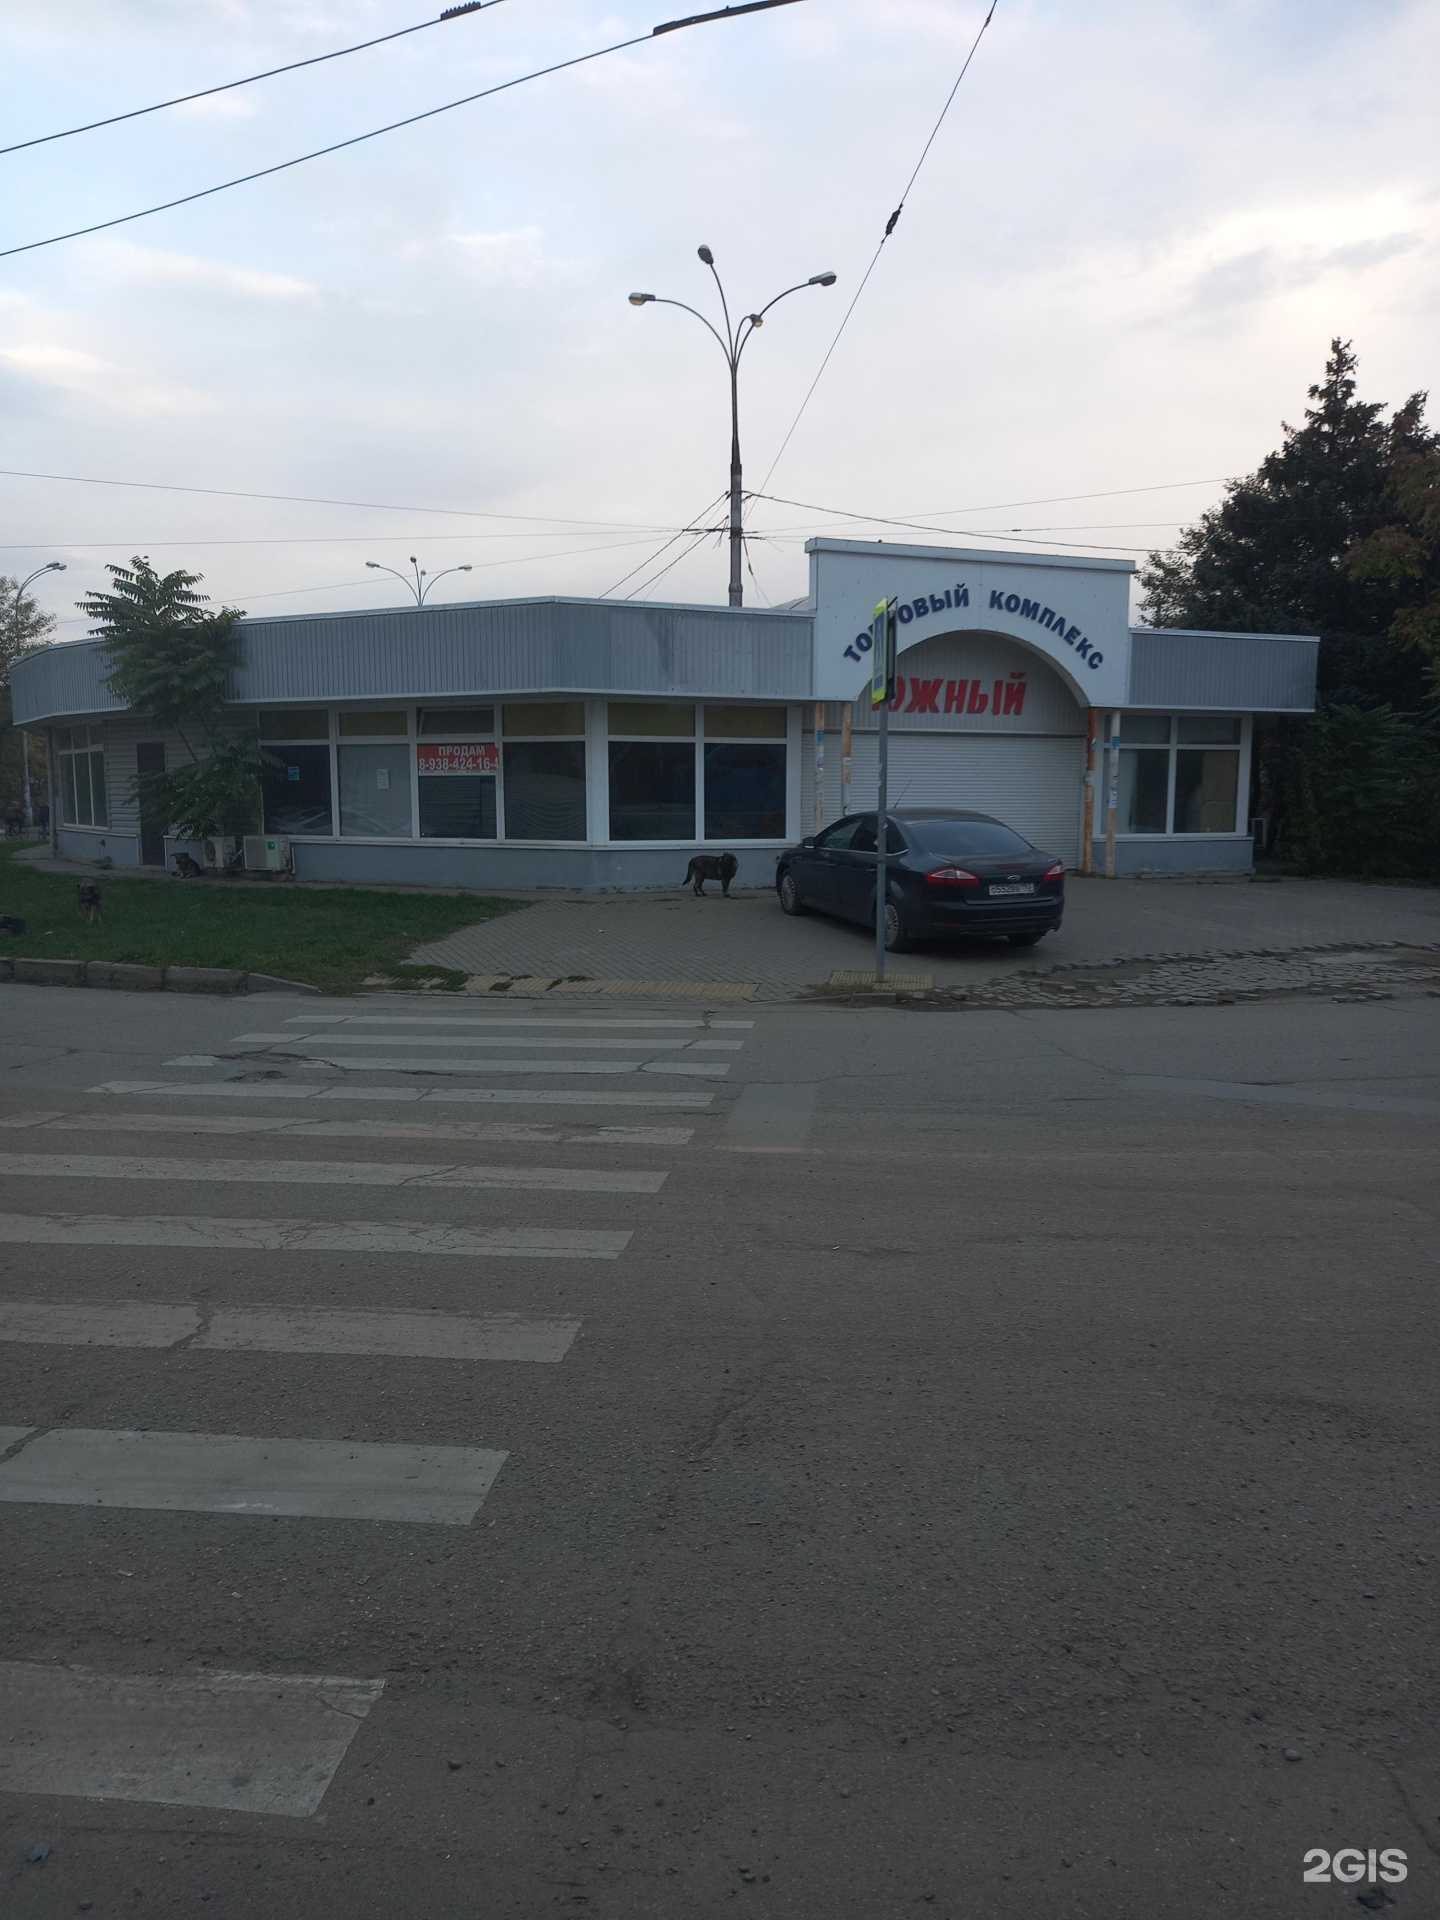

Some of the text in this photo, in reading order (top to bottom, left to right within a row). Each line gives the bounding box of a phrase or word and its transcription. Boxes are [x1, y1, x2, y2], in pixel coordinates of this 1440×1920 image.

[844, 583, 1103, 669] ТООВЫЙ КОМПЛЕКС
[439, 745, 485, 757] ПРОДАМ
